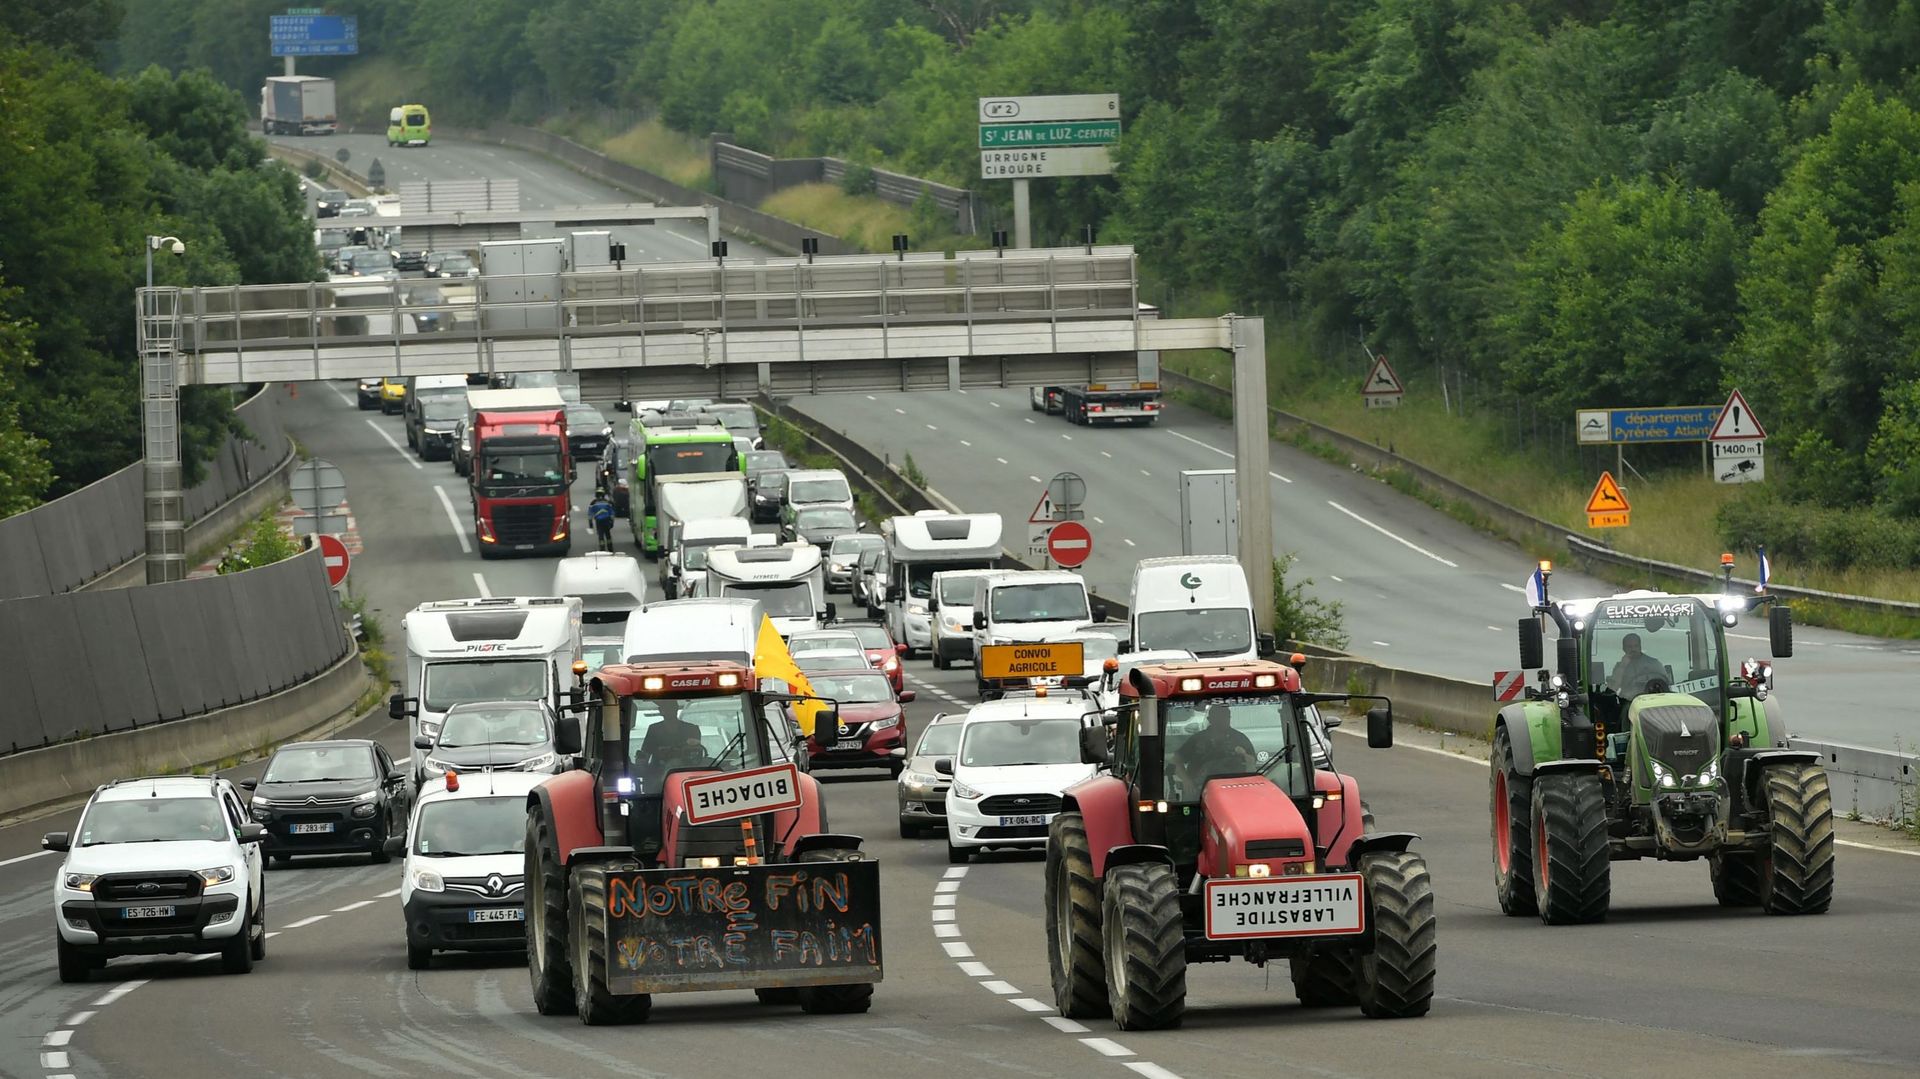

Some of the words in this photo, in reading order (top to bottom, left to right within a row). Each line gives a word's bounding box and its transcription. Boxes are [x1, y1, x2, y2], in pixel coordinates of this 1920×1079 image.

[1006, 105, 1012, 113] 2
[1108, 102, 1115, 110] 6
[1001, 129, 1032, 142] JEAN
[1050, 128, 1072, 139] LUZ
[985, 152, 1046, 162] URRUGNE
[985, 164, 1042, 174] CIBOURE
[1625, 412, 1702, 425] département
[1616, 426, 1668, 440] Pyrénées
[1675, 426, 1711, 436] Atlanti
[1722, 445, 1745, 454] 1400
[1606, 603, 1694, 615] EUROMAGRI
[1014, 648, 1050, 659] CONVOI
[1009, 662, 1057, 673] AGRICOLE
[1676, 684, 1695, 693] TITI
[698, 778, 787, 808] BIDACHE
[1216, 888, 1352, 906] VILLEFRANCHE
[1236, 908, 1334, 925] LABASTIDE
